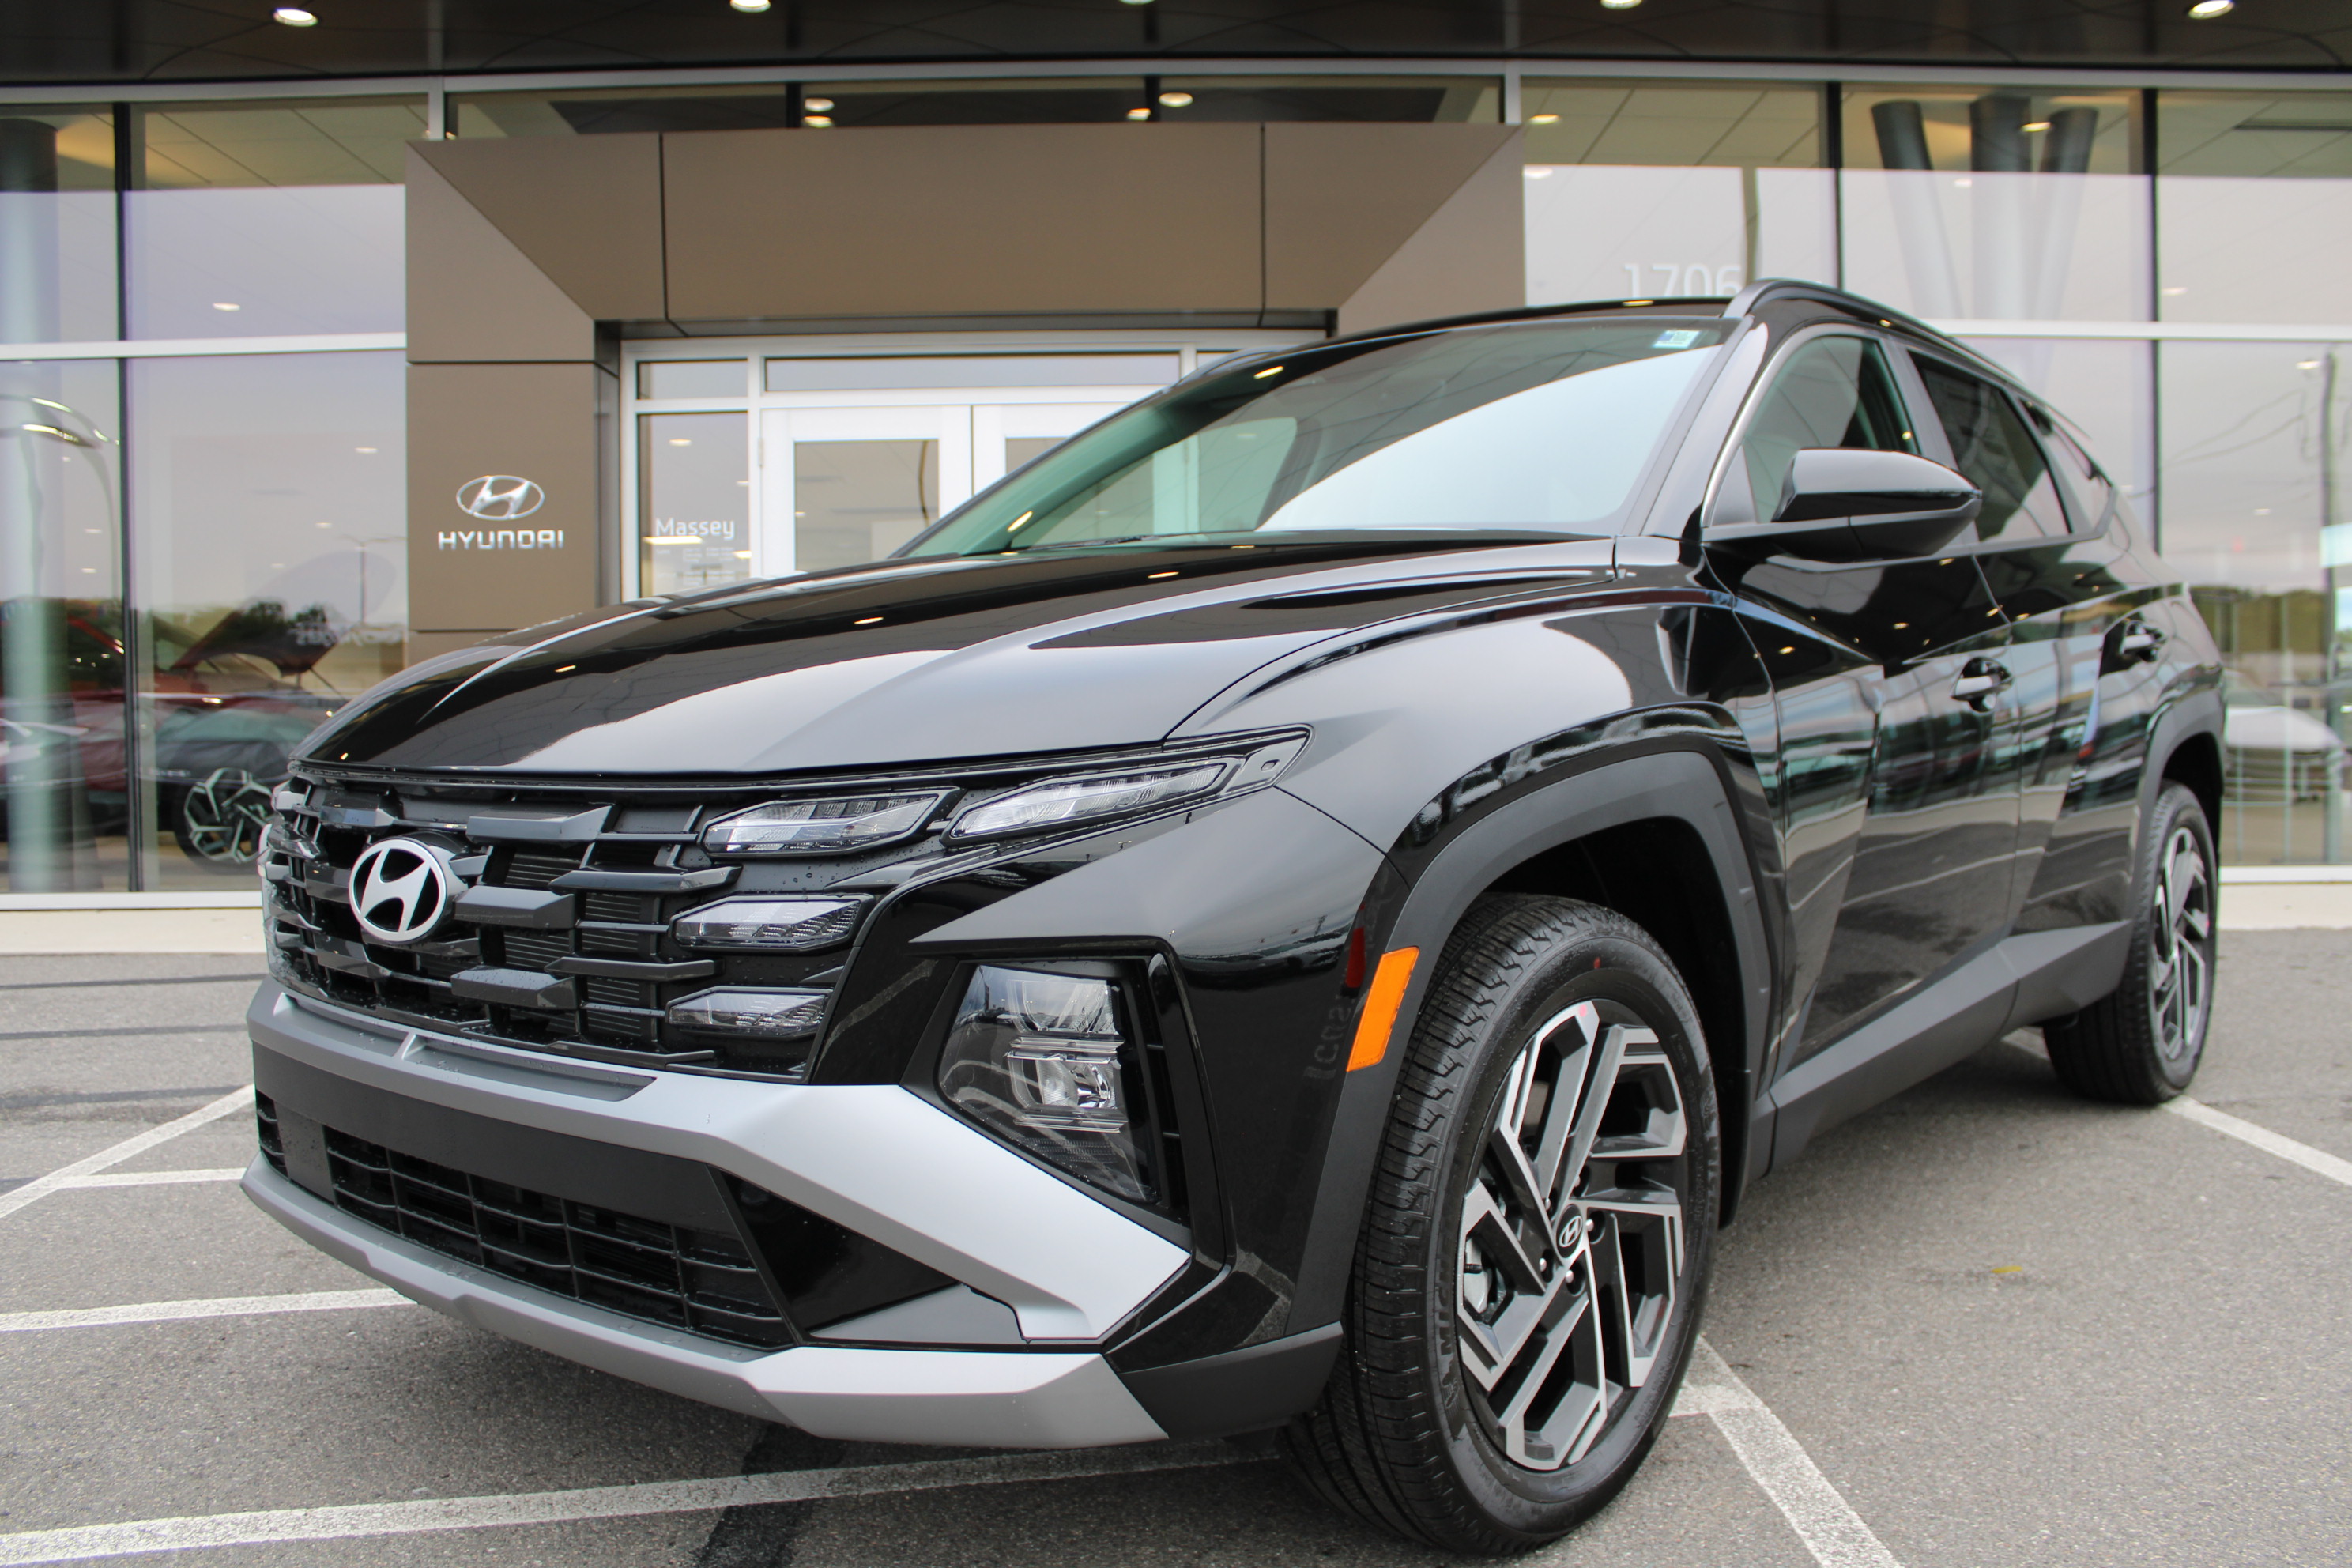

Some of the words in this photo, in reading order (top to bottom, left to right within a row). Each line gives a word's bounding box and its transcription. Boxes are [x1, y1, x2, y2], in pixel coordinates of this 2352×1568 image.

[1623, 263, 1743, 297] 1706
[438, 530, 564, 550] HYUNDAI
[655, 518, 735, 541] Massey
